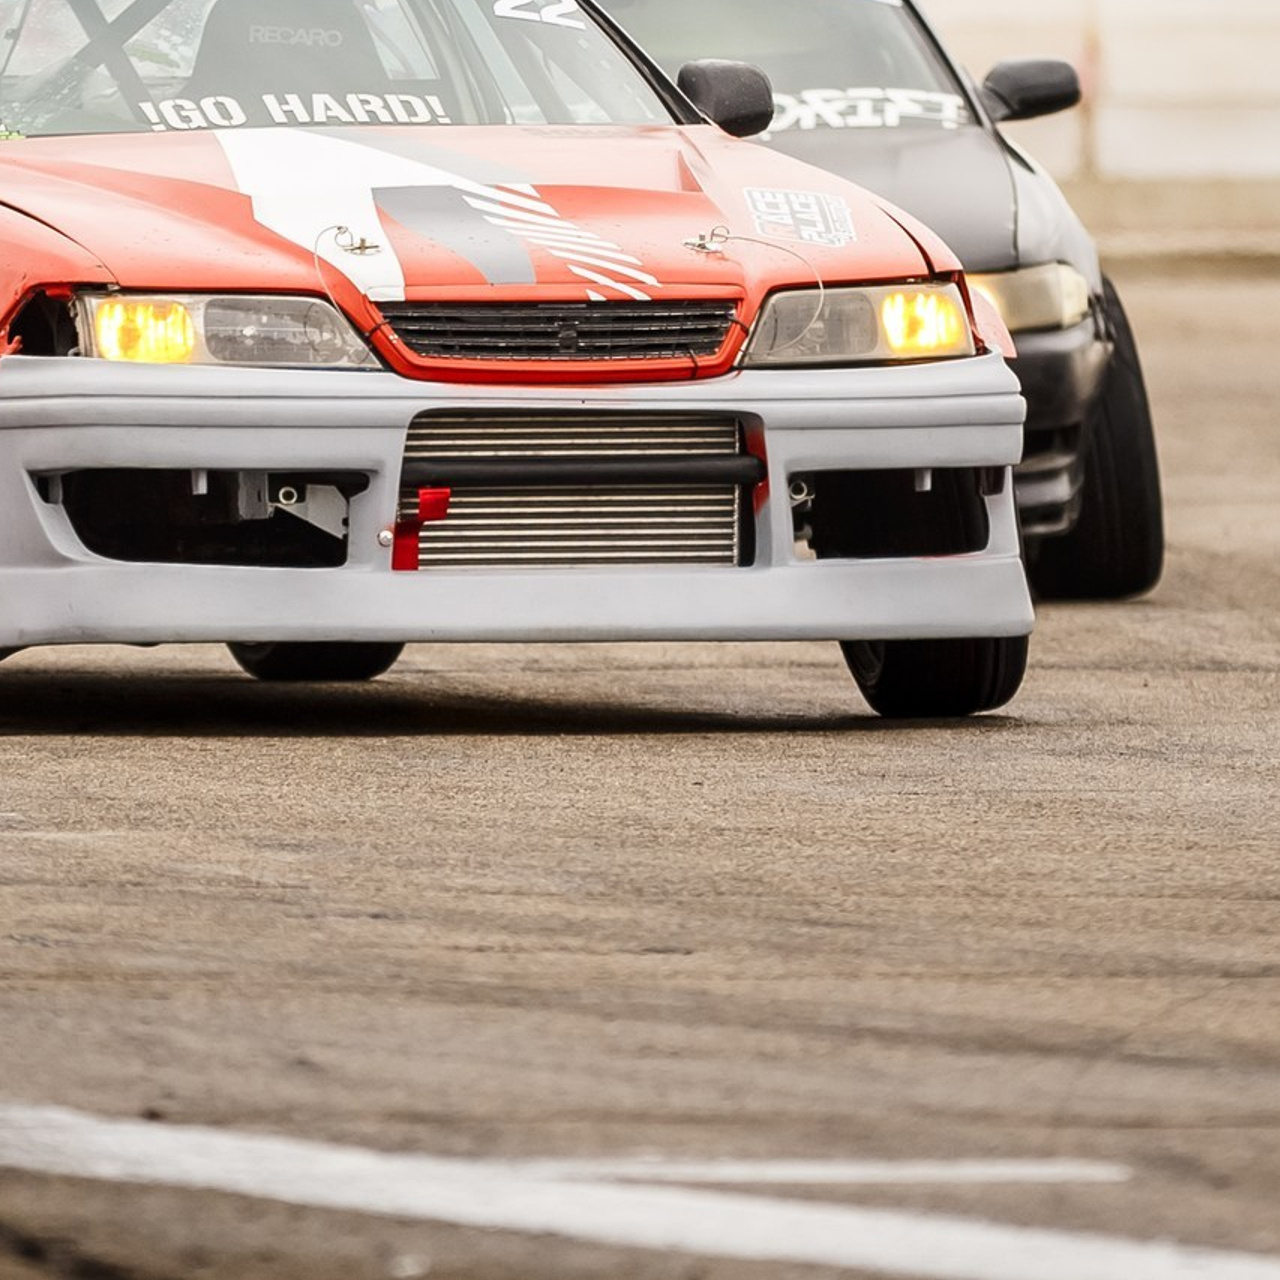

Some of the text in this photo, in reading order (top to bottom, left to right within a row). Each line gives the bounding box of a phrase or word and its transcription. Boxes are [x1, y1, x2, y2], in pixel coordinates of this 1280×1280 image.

[249, 25, 342, 47] RECARO
[138, 92, 452, 131] !GO HARD!
